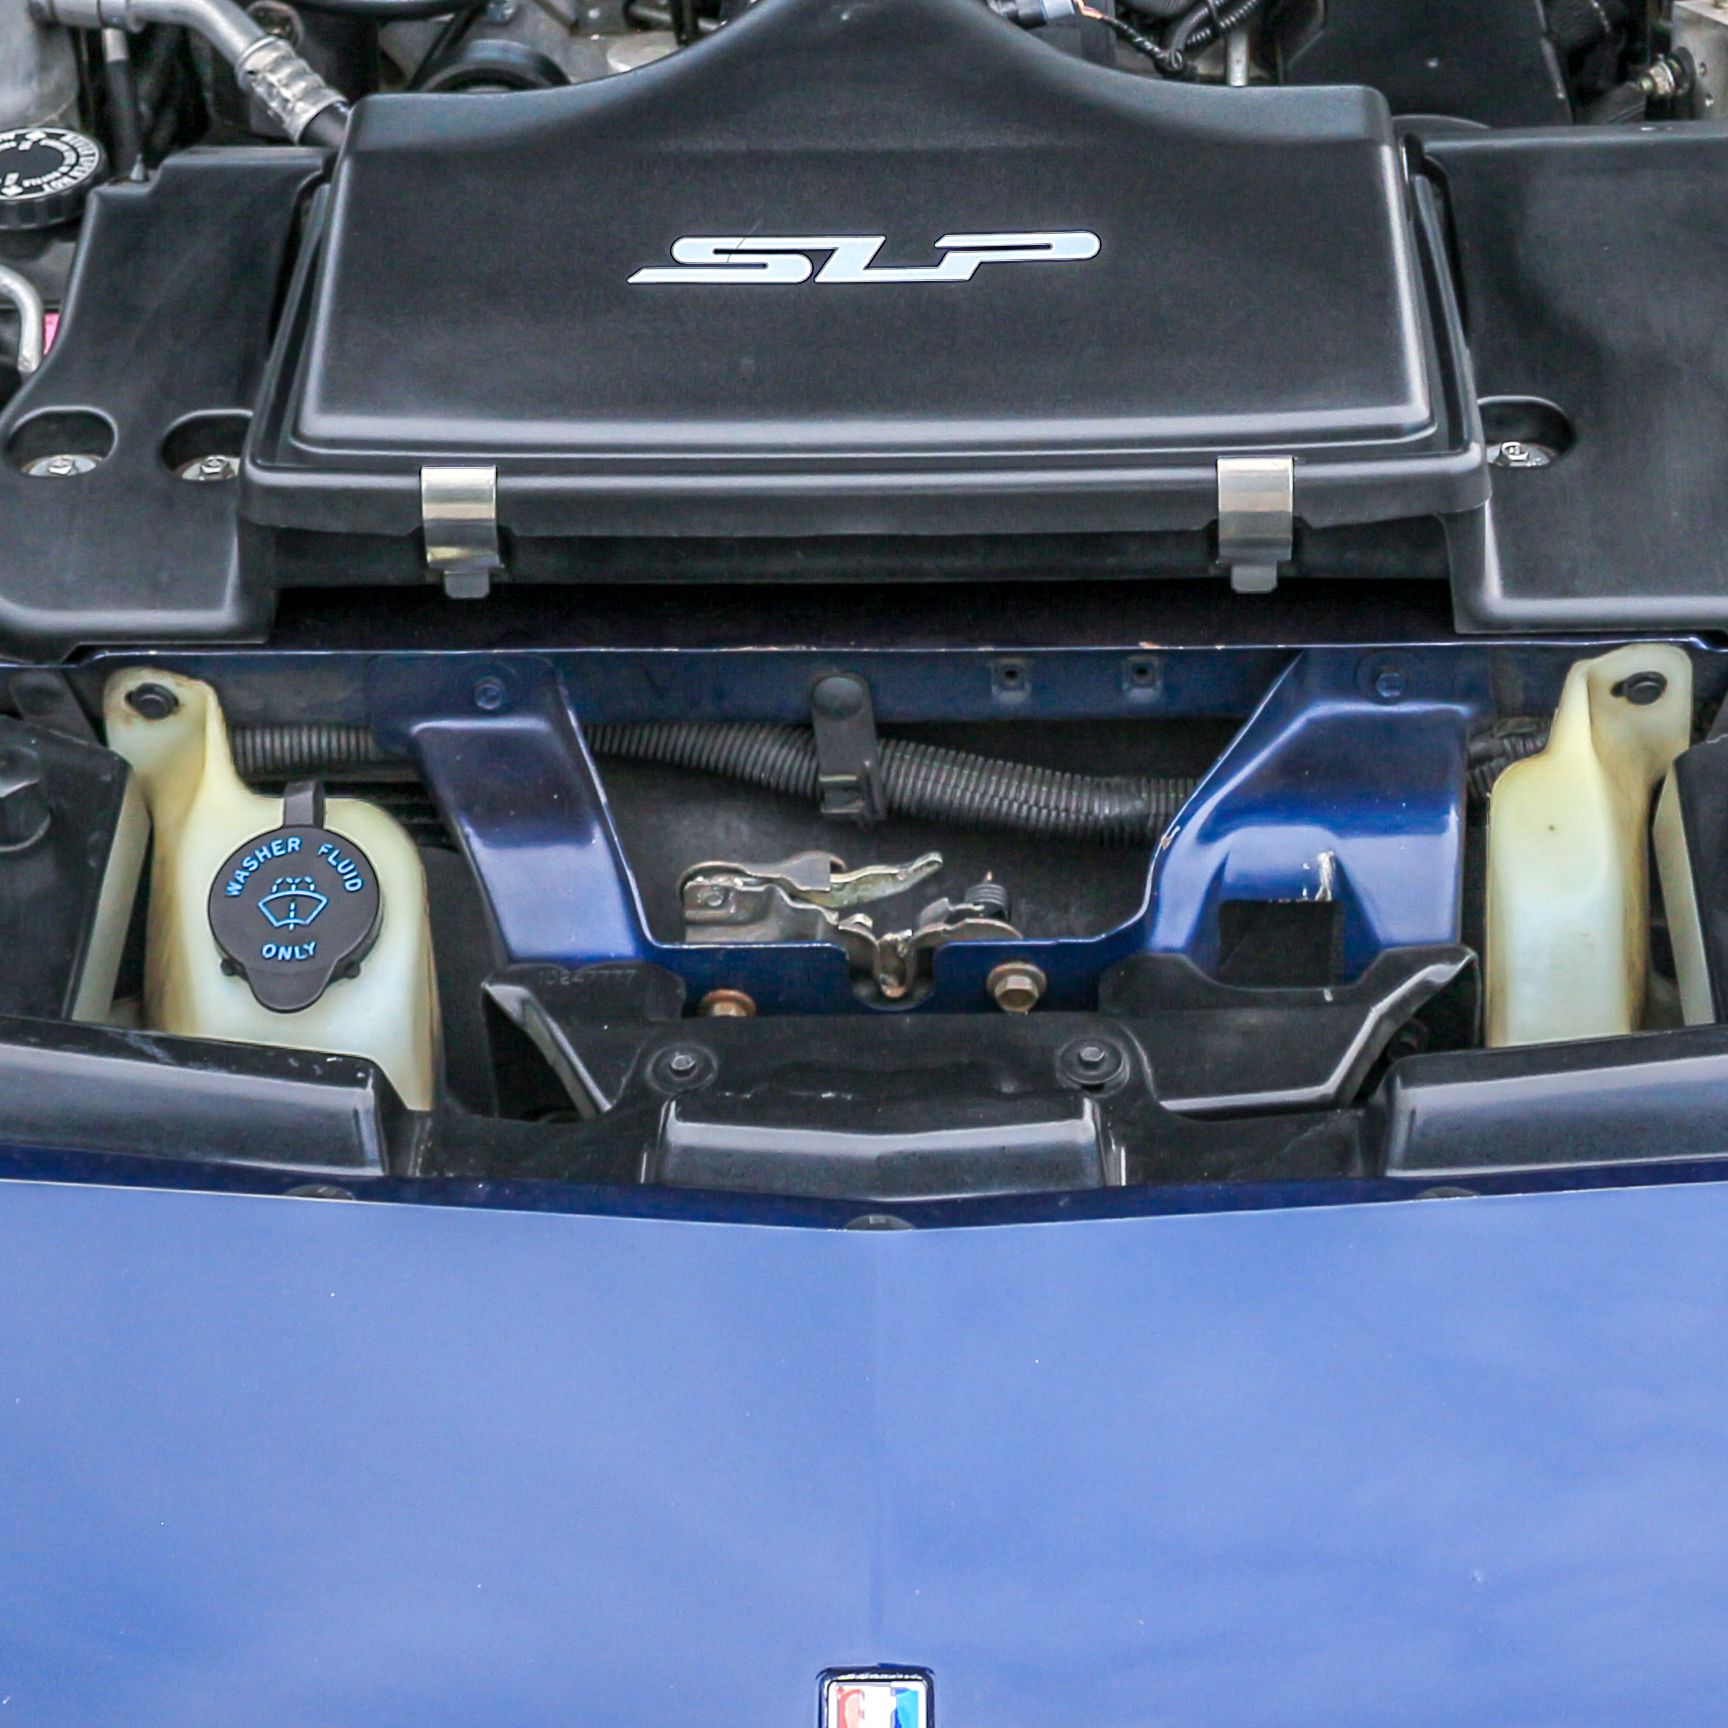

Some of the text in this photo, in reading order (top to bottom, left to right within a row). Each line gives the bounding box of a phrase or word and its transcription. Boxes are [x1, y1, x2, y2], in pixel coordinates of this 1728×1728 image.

[626, 229, 1102, 285] SLP
[224, 836, 364, 897] WASHER FLUID
[261, 940, 317, 962] ONLY
